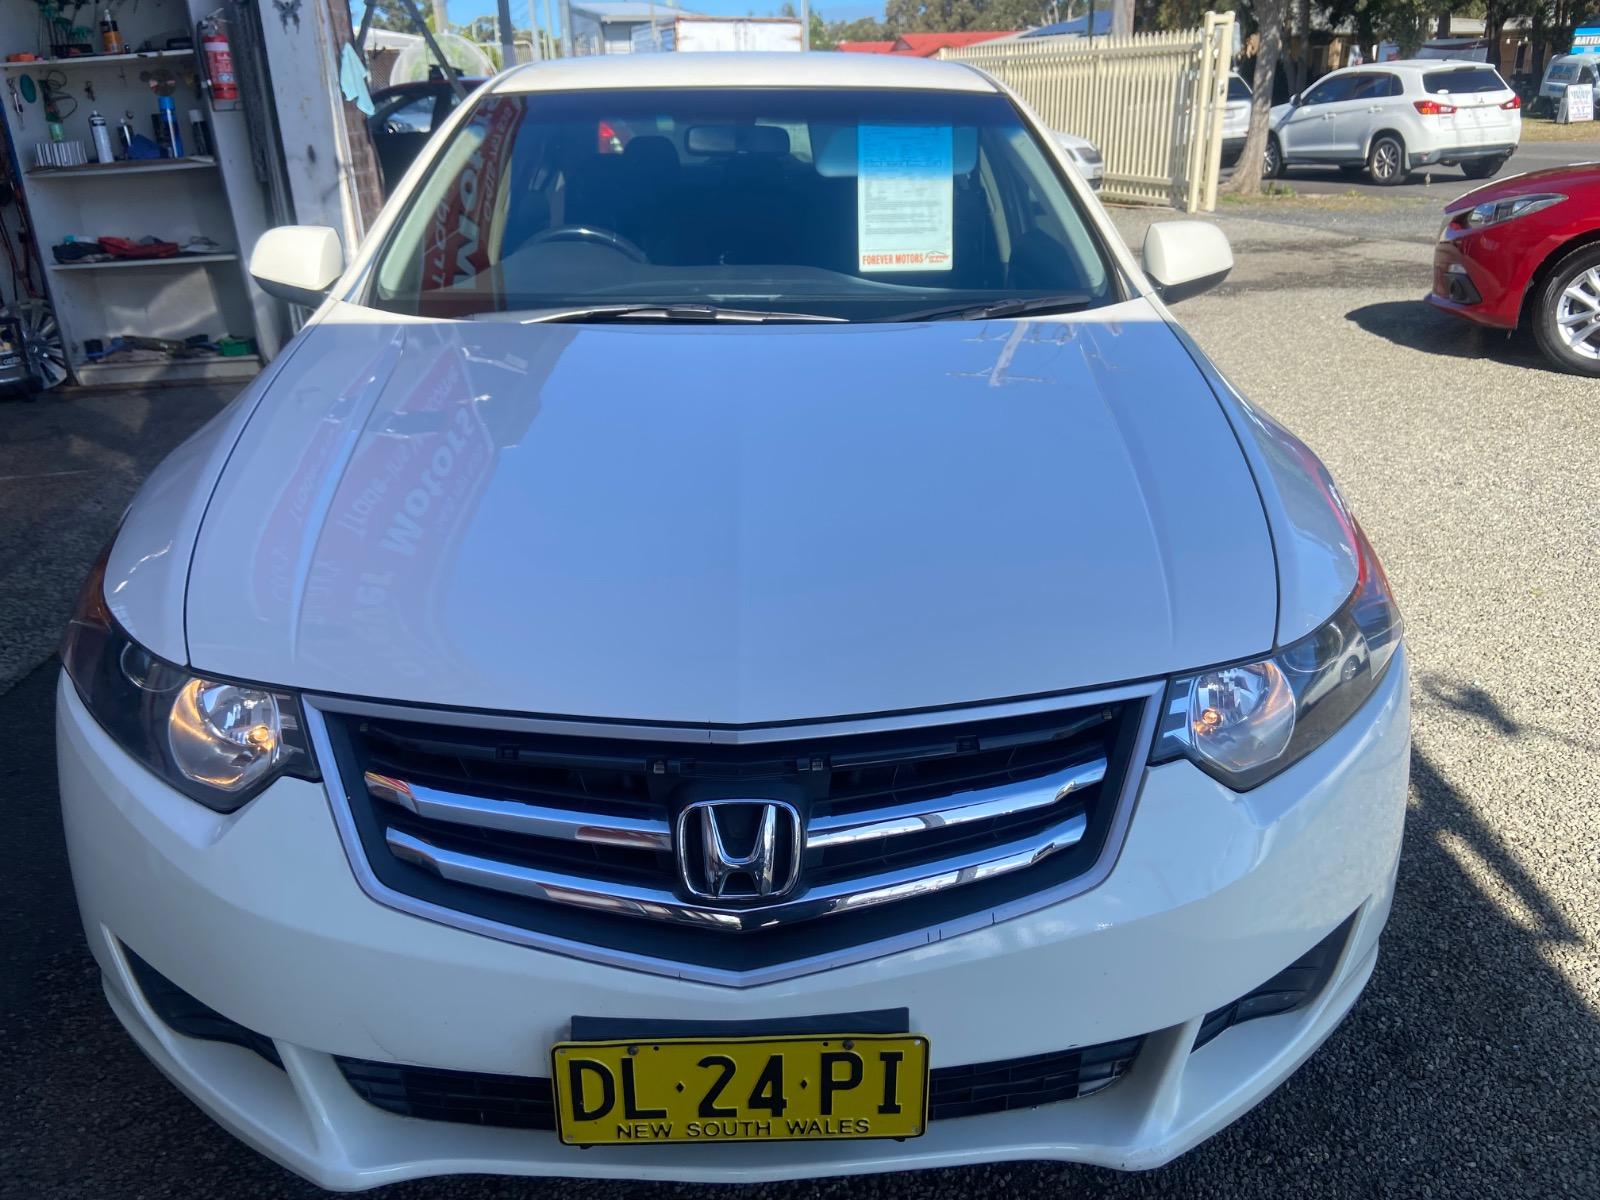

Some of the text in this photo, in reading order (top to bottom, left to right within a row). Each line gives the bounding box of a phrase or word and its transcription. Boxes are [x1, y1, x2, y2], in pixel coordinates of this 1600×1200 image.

[863, 255, 893, 265] FOREVER
[895, 253, 923, 264] MOTORS
[569, 1051, 904, 1121] DL 24 PI
[617, 1119, 870, 1139] NEW SOUTH WALES
